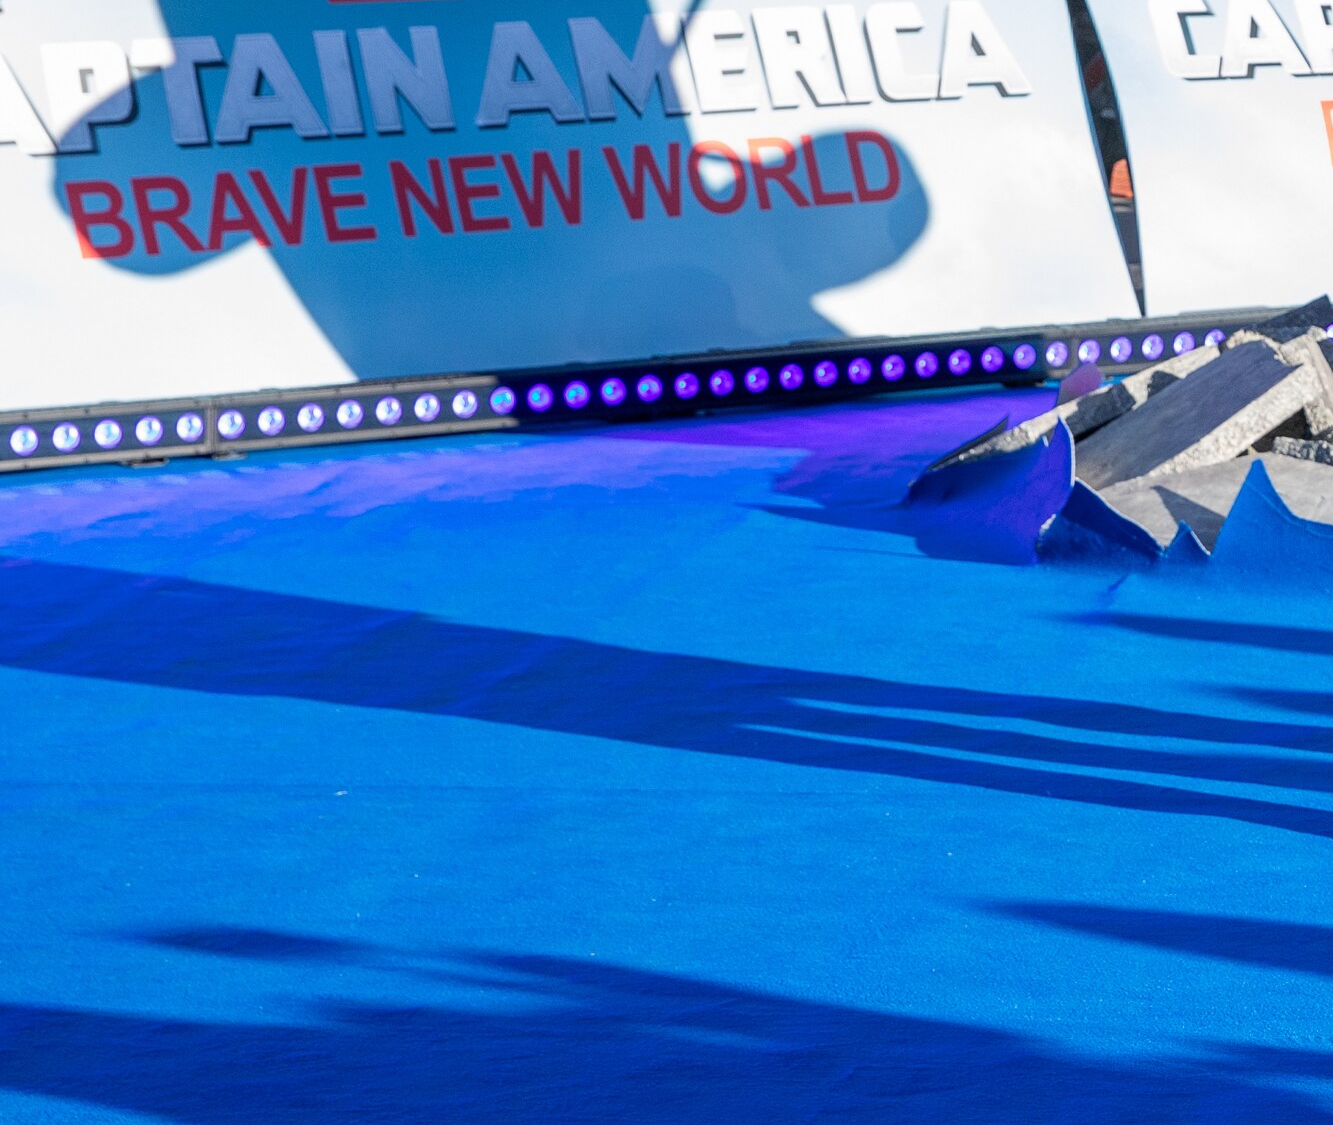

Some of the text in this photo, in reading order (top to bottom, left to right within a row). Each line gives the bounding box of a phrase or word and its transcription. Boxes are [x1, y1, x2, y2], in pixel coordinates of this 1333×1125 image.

[475, 0, 1033, 129] AMERICA
[63, 130, 901, 259] BRAVE NEW WORLD
